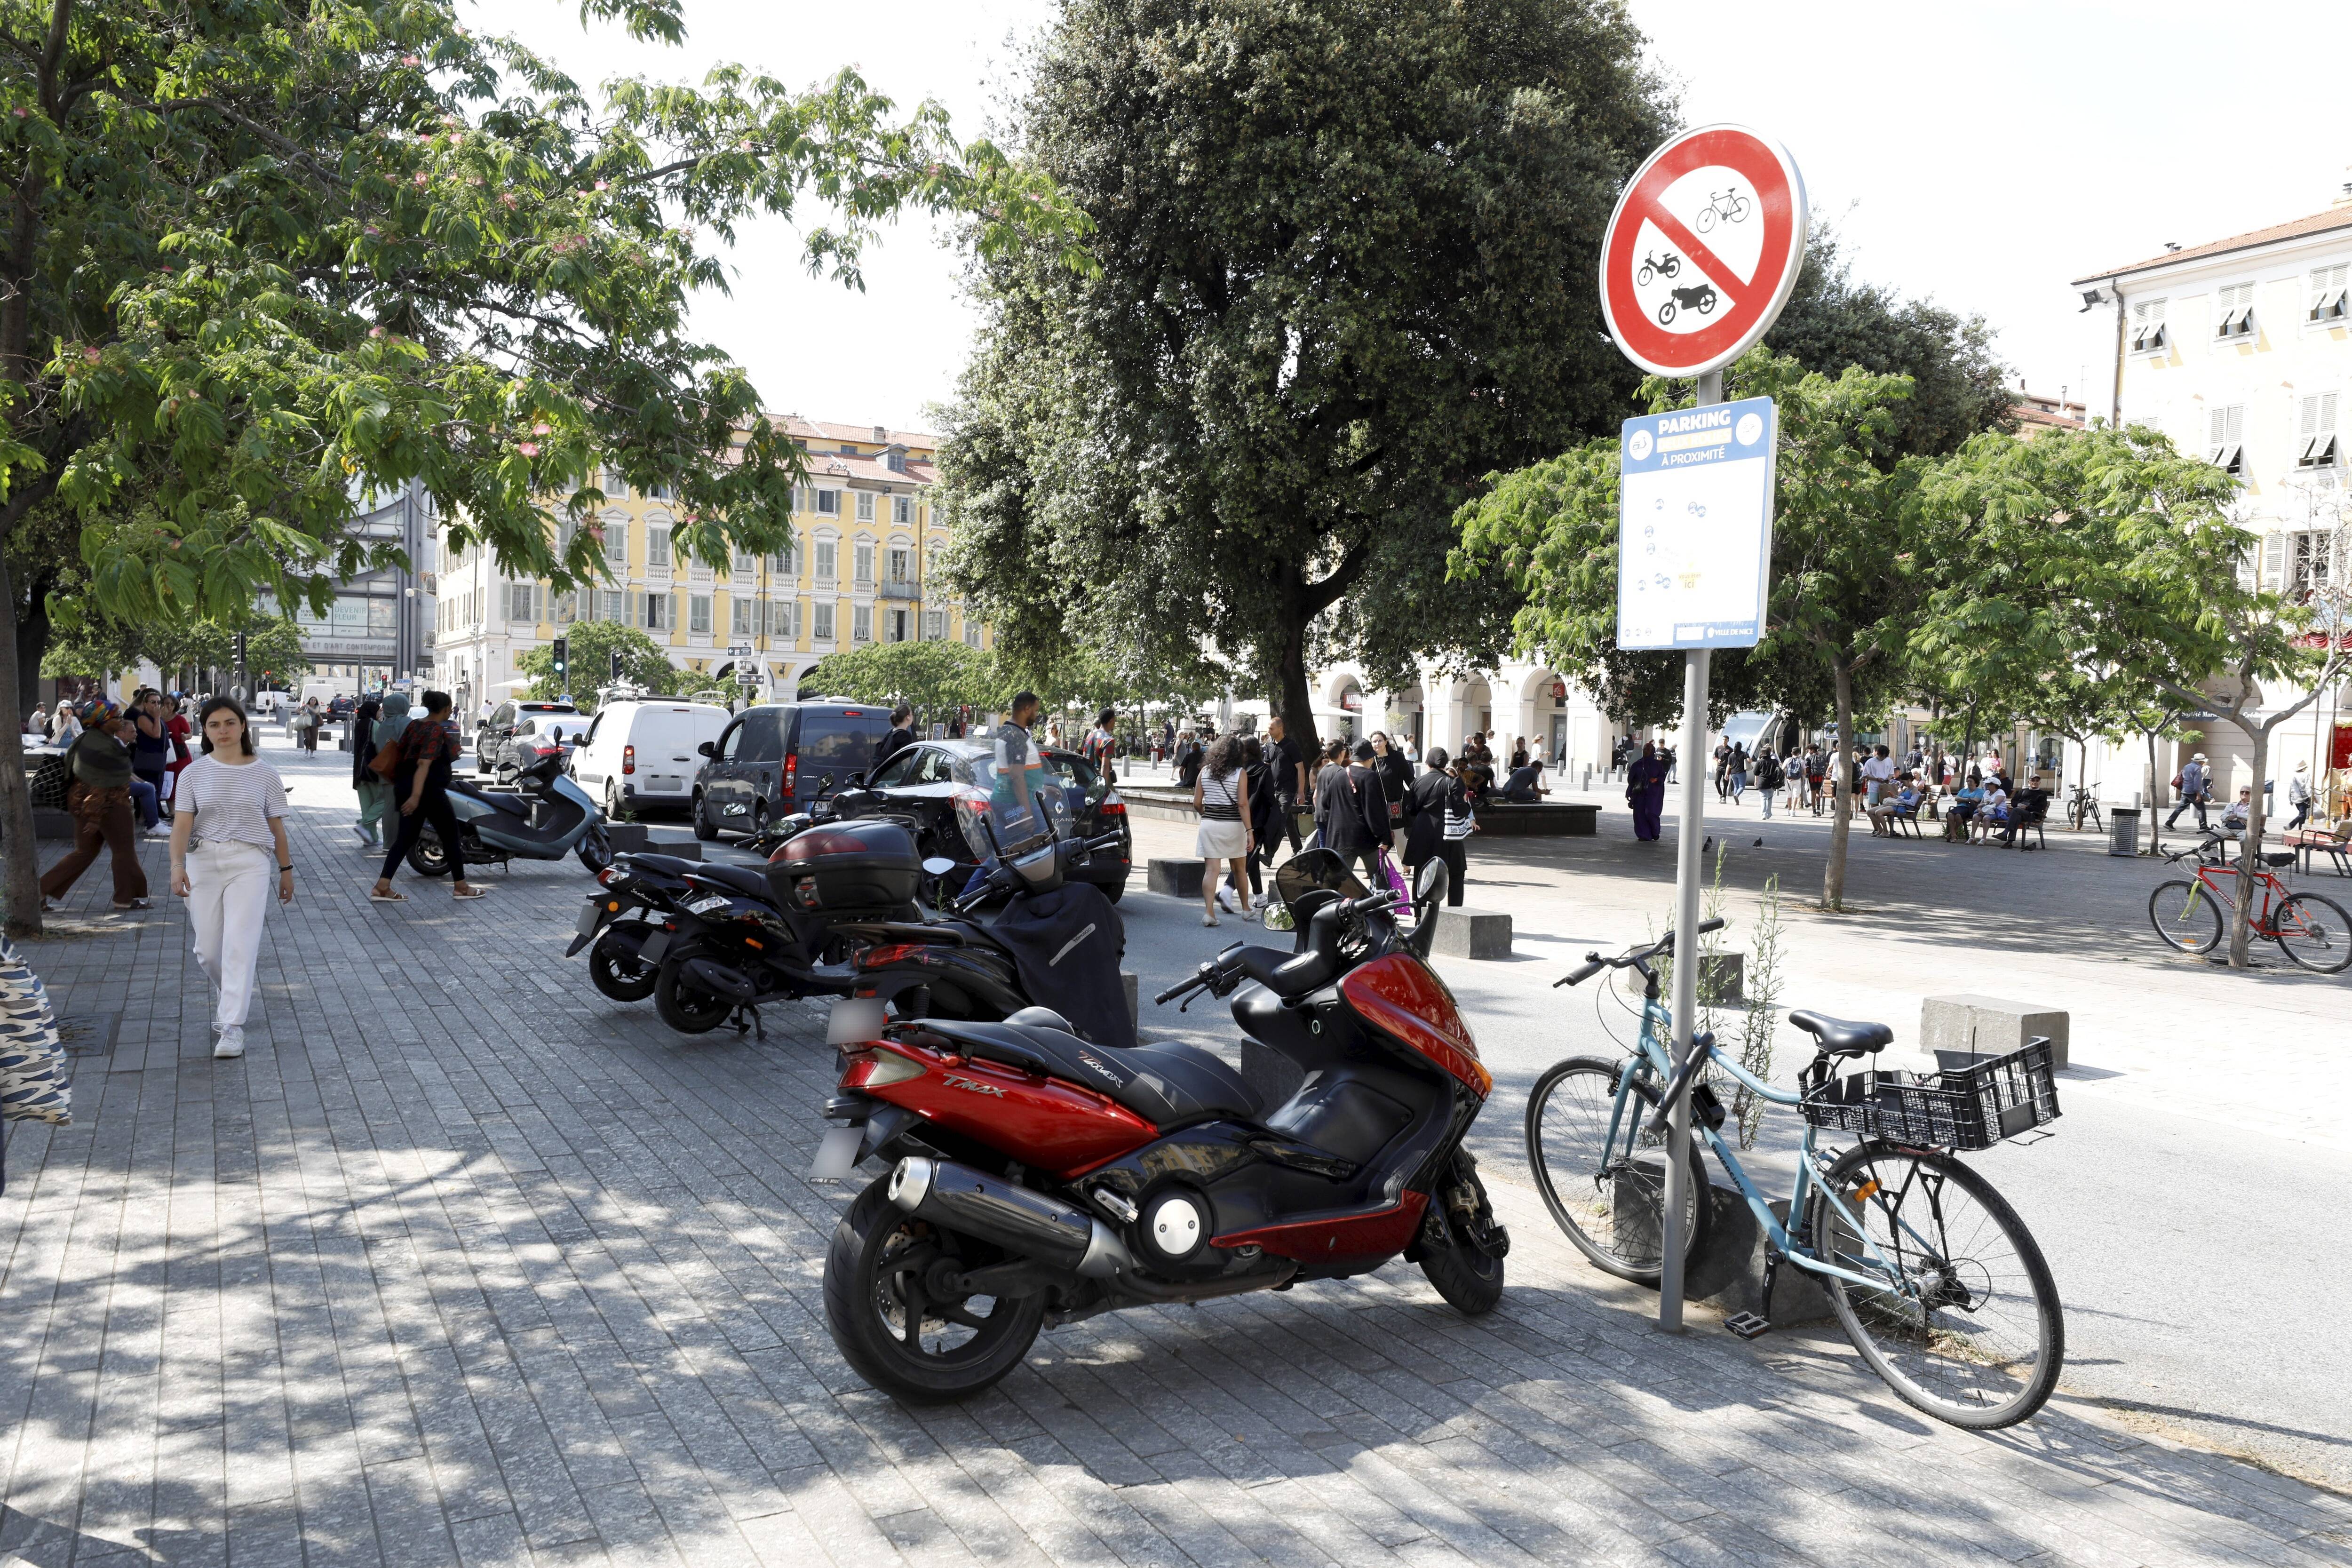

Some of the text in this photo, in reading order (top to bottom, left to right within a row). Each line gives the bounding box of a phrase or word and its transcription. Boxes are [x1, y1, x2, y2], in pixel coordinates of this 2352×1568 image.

[1659, 409, 1731, 435] PARKING
[1661, 445, 1725, 466] À PROXIMITÉ
[1685, 579, 1694, 588] ici
[1078, 1050, 1123, 1089] TMAX
[943, 1073, 1009, 1098] TMAX
[1711, 1144, 1745, 1193] RIVERSIDE
